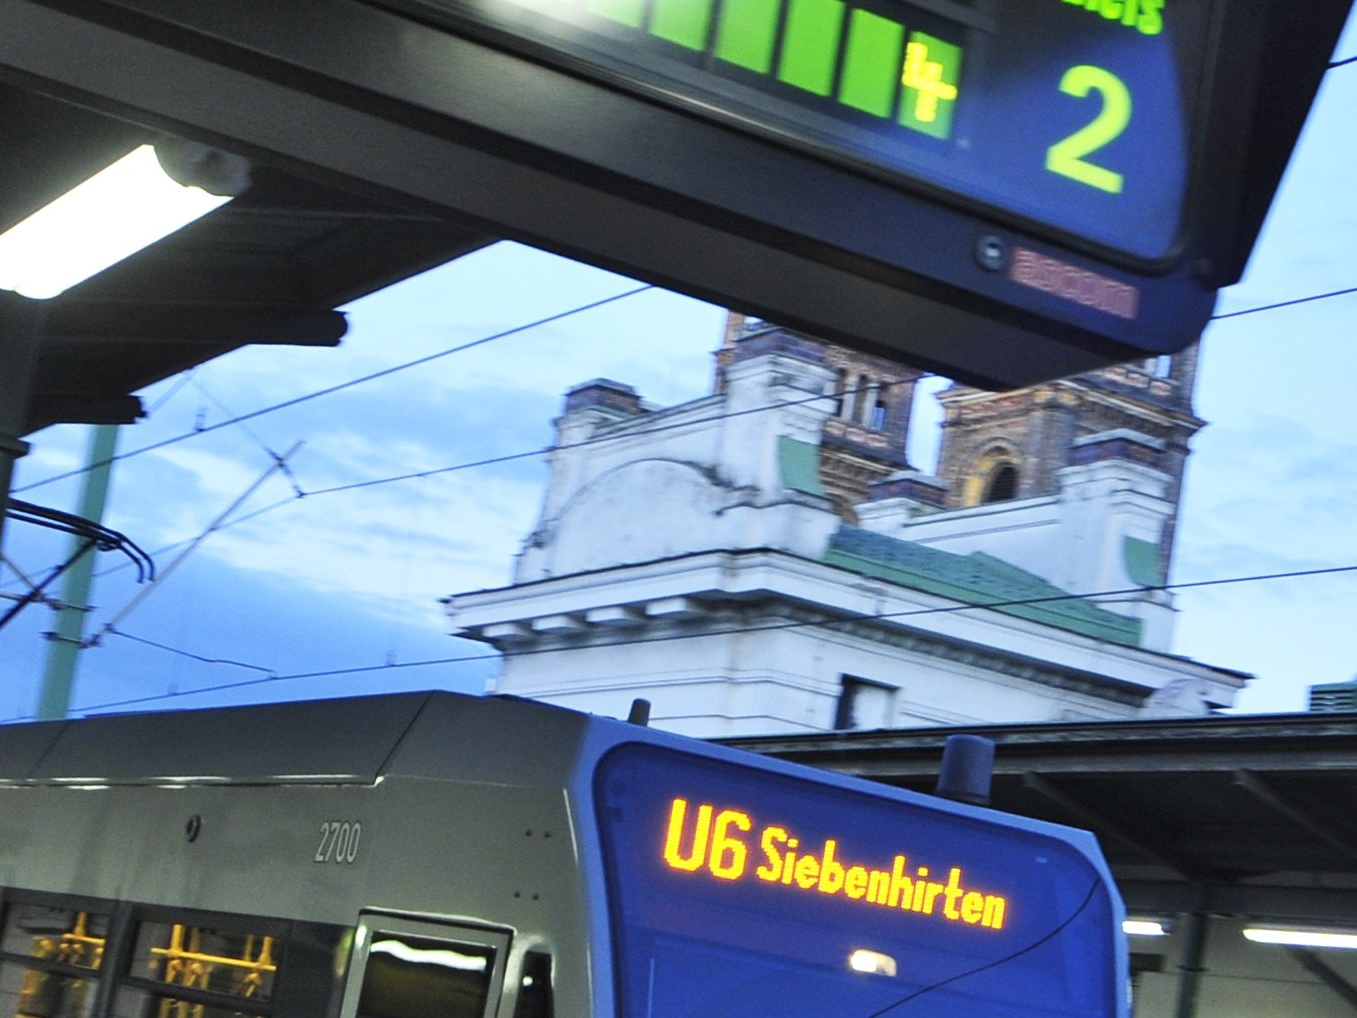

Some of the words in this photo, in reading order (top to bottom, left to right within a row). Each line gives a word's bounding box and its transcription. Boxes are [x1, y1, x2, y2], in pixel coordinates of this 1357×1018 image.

[1044, 64, 1133, 194] 2
[314, 821, 362, 864] 2700
[663, 798, 751, 880] U6
[756, 826, 1005, 930] Siebenhirten
